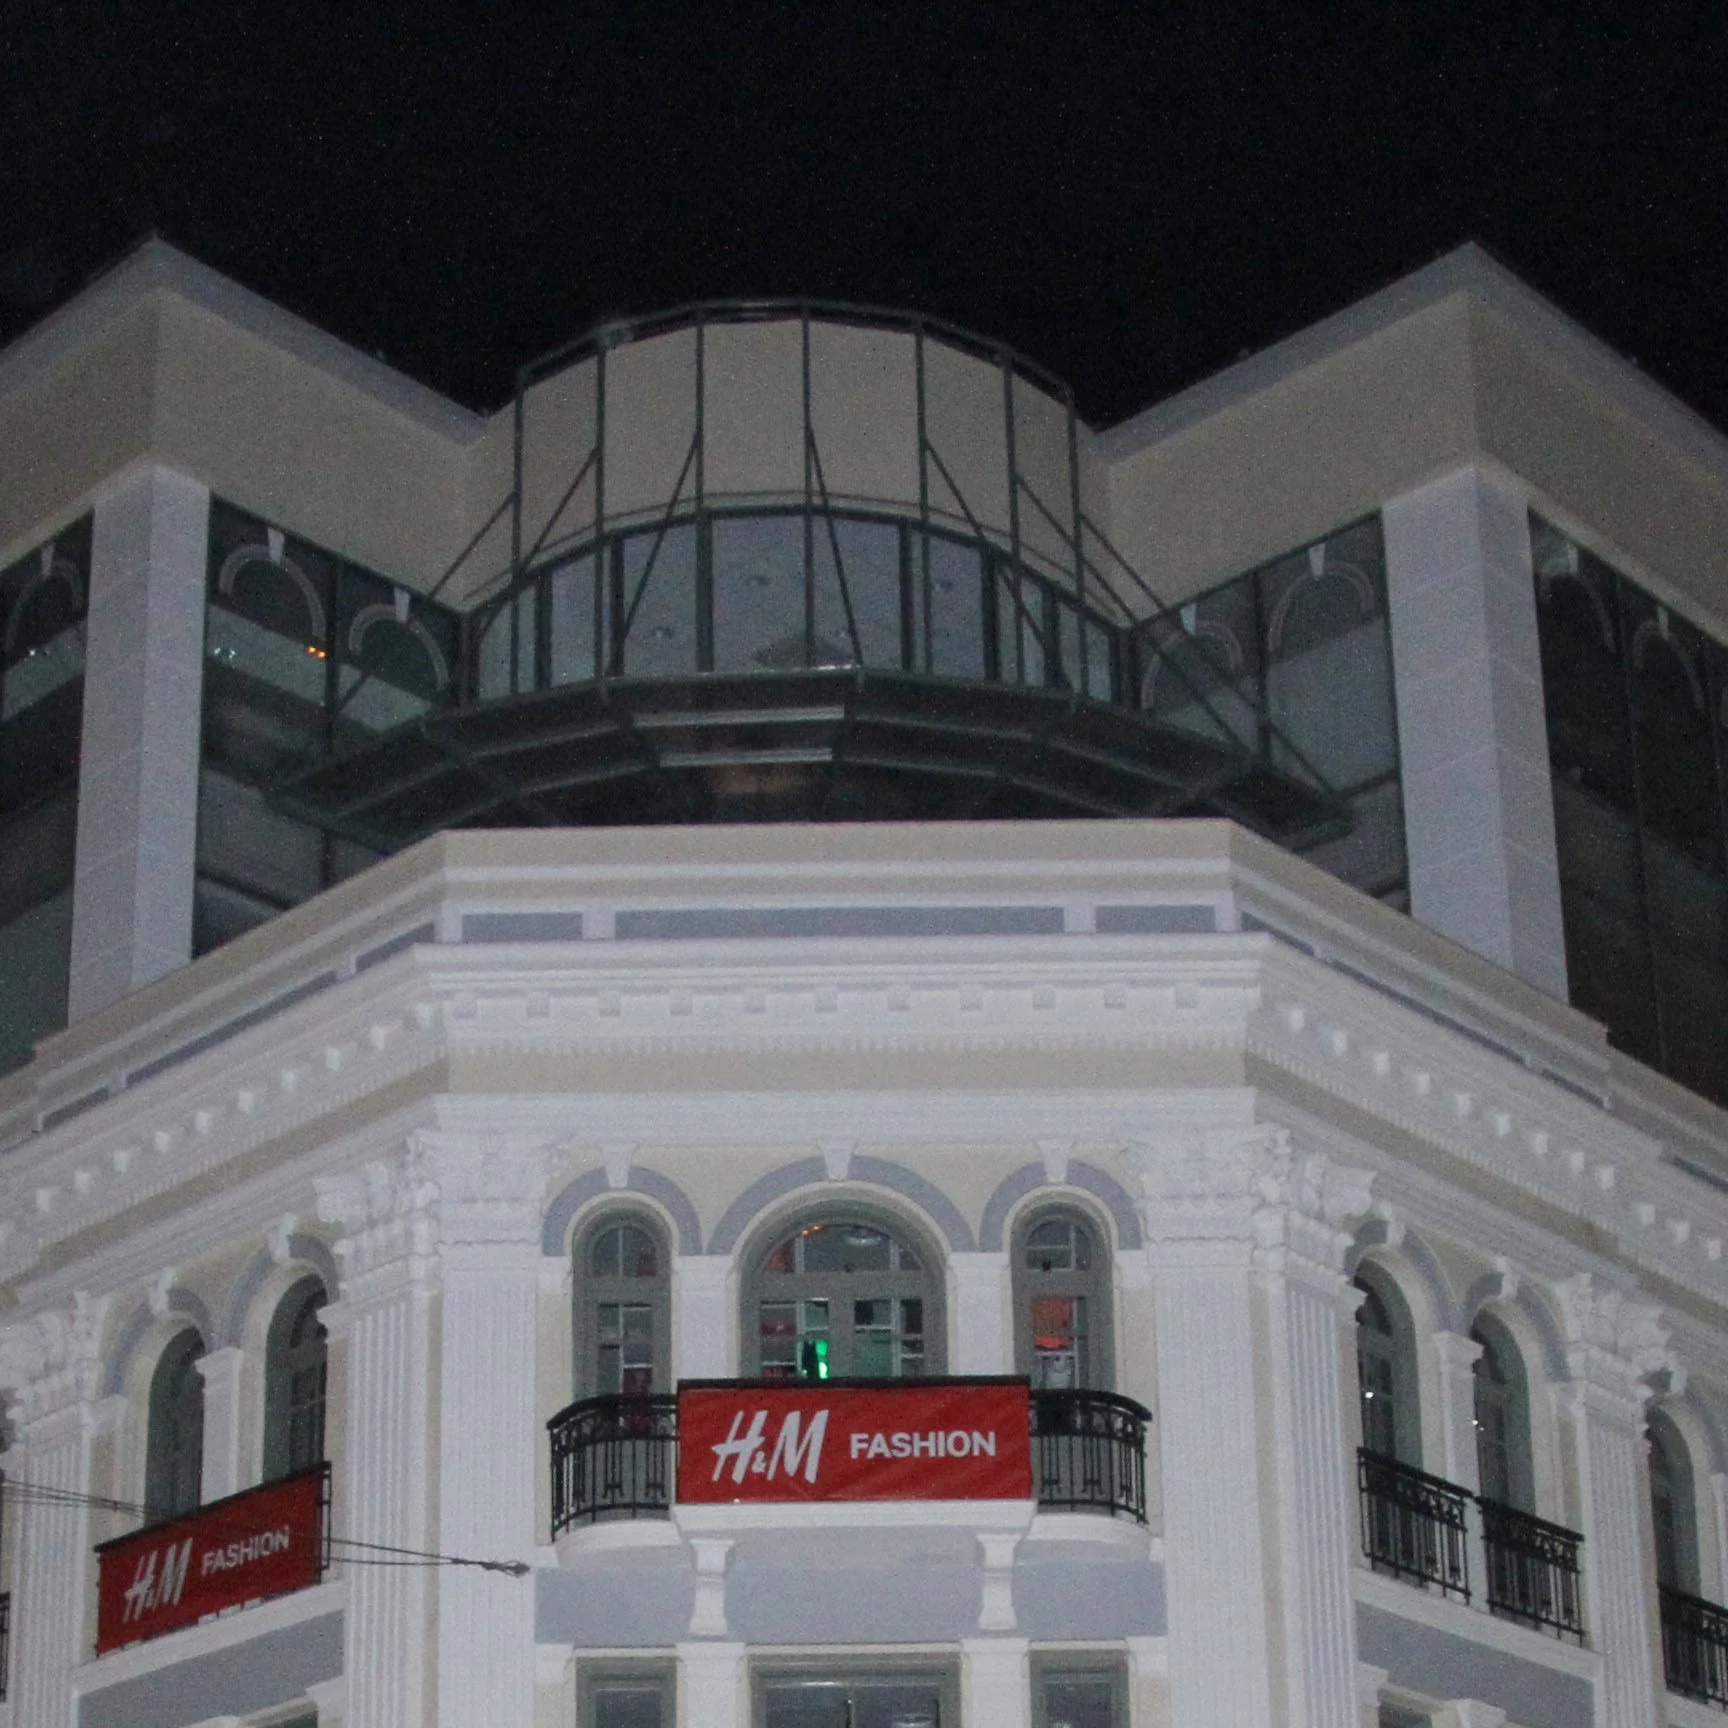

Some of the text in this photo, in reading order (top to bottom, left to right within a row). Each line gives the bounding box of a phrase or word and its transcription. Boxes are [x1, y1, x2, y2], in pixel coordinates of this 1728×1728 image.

[712, 1409, 996, 1484] H&M FASHION
[123, 1526, 290, 1624] H&M FASHION
